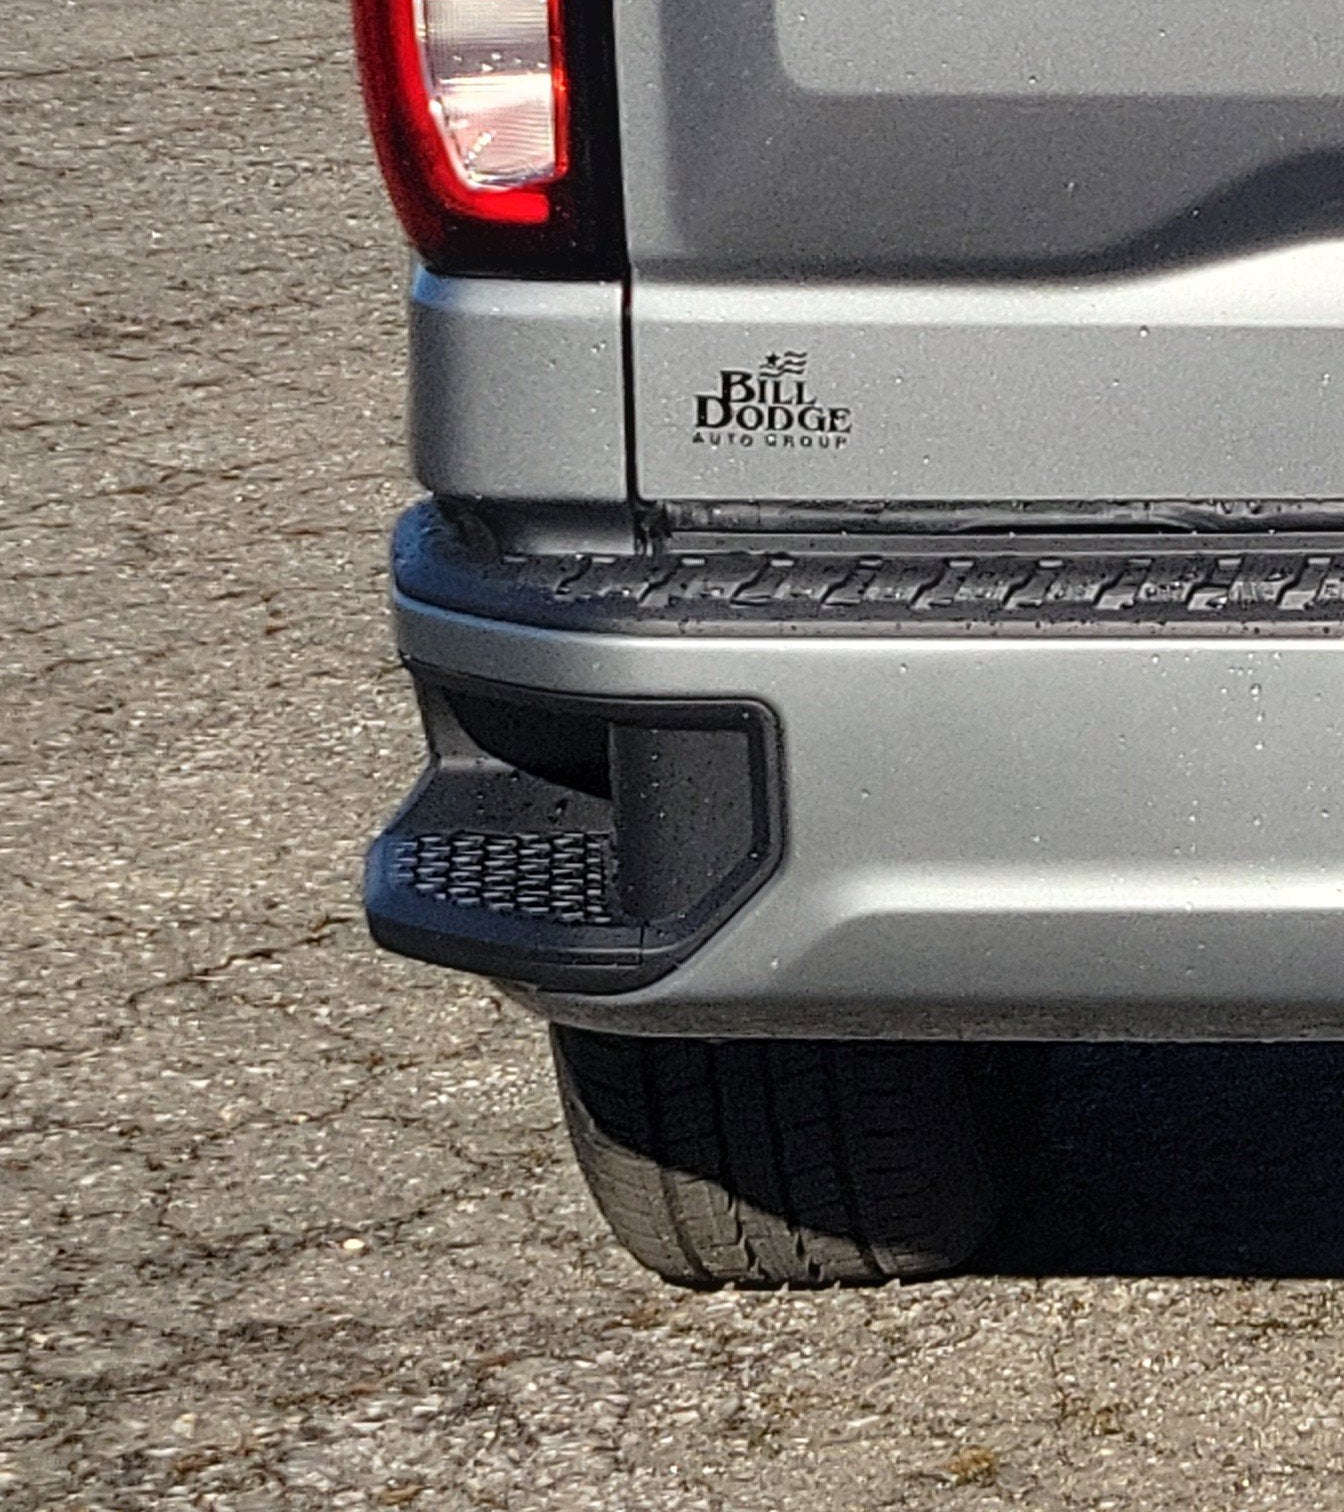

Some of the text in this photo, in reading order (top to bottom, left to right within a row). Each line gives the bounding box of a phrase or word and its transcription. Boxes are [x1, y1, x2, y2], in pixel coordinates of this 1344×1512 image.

[720, 370, 817, 406] BILL
[694, 394, 852, 433] DODGE
[692, 432, 847, 449] AUTO GROUP
